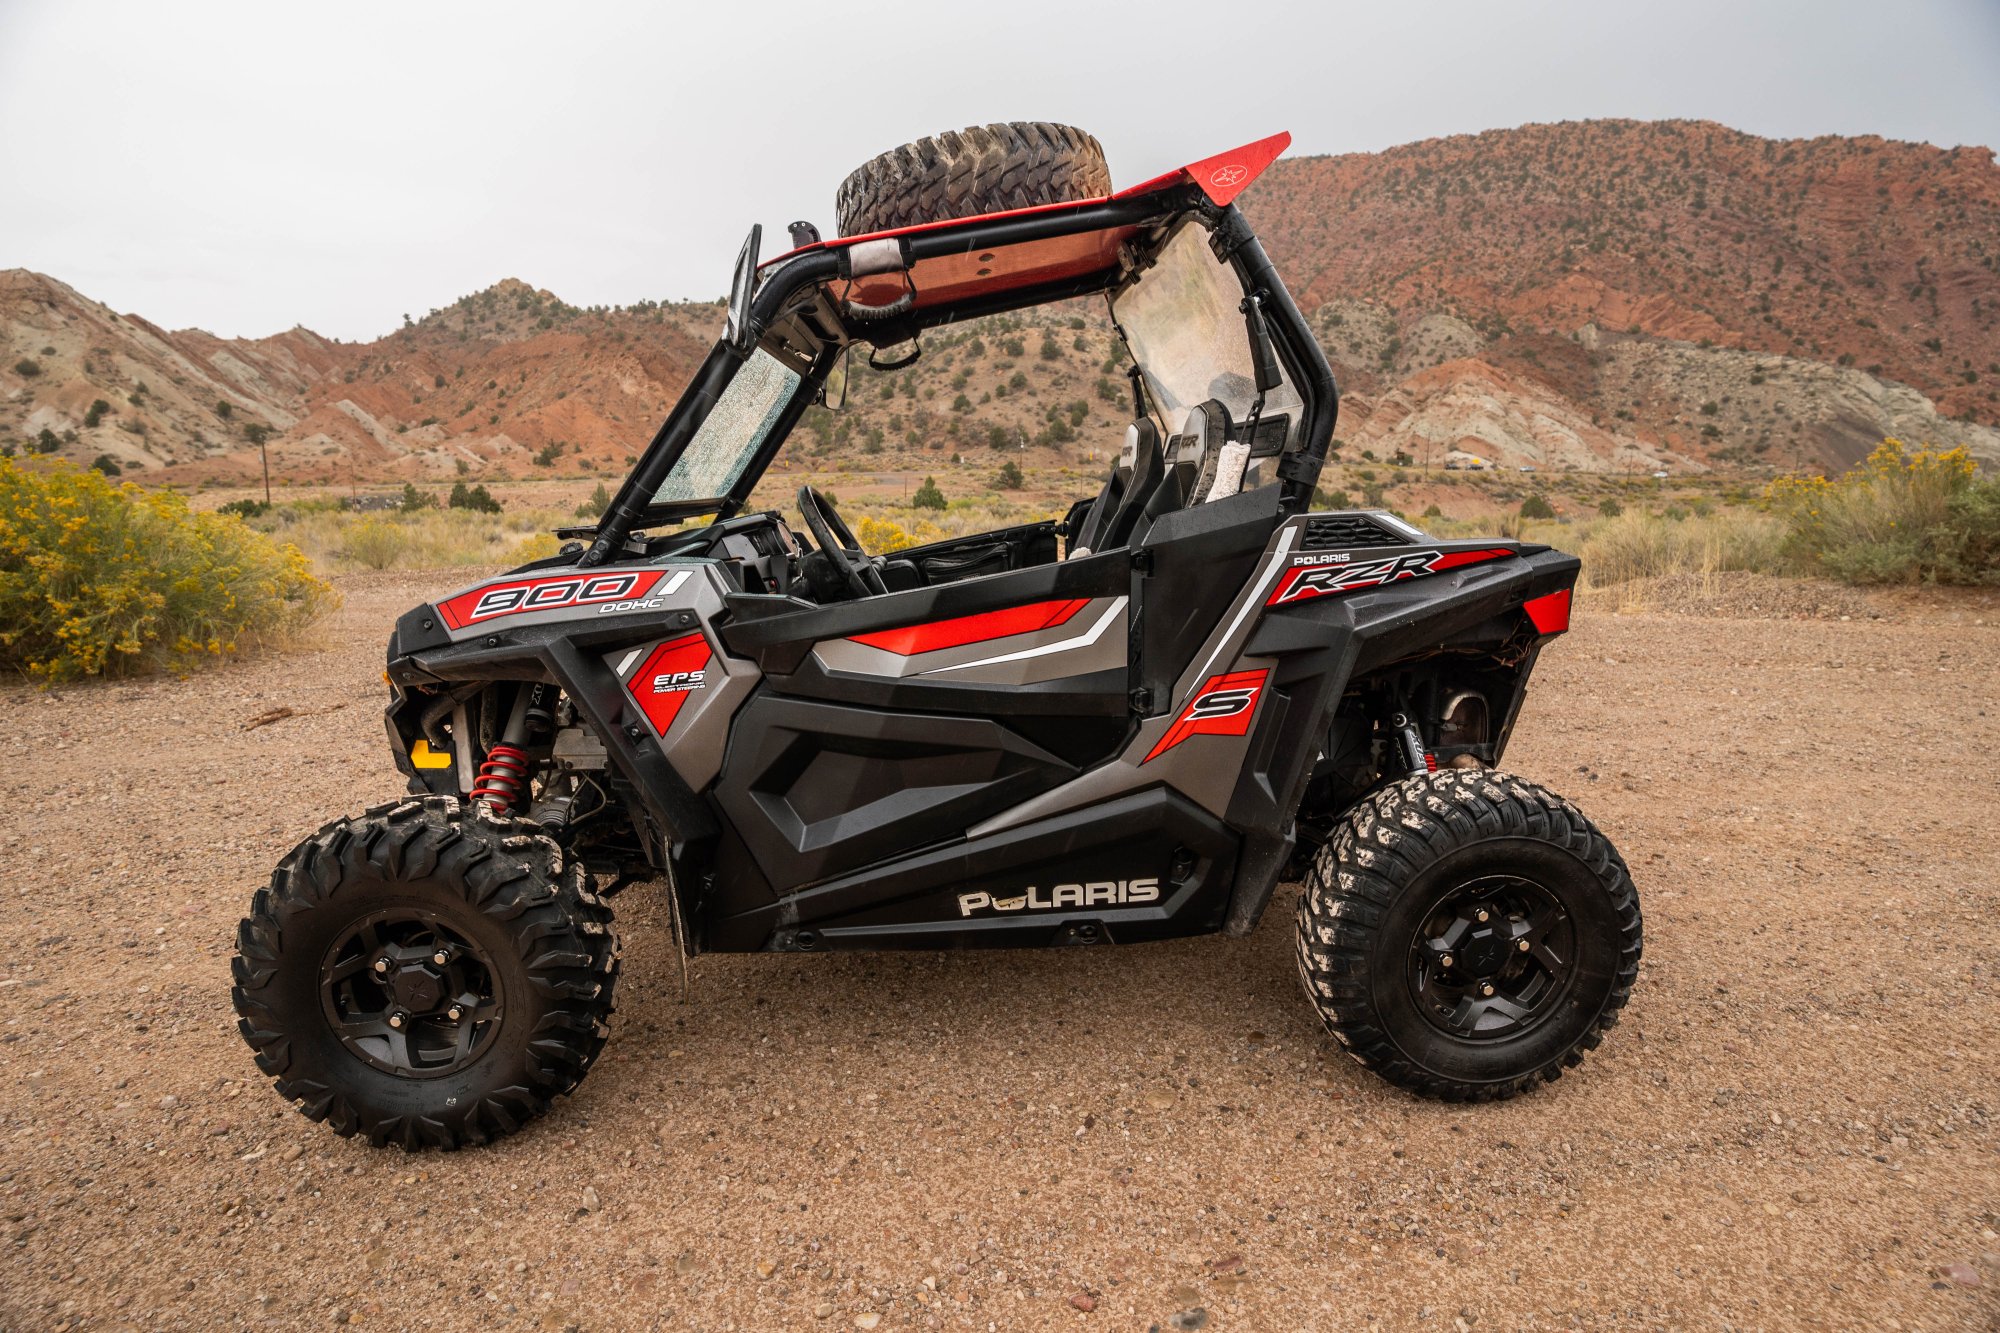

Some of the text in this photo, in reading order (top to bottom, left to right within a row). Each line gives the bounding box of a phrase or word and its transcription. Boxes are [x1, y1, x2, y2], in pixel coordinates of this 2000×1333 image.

[1294, 553, 1350, 566] POLARIS
[1276, 550, 1444, 604] RZR
[470, 573, 640, 619] 900
[598, 598, 665, 614] DOHC
[653, 670, 706, 686] EPS
[676, 684, 706, 692] STEERING
[1183, 687, 1259, 721] S
